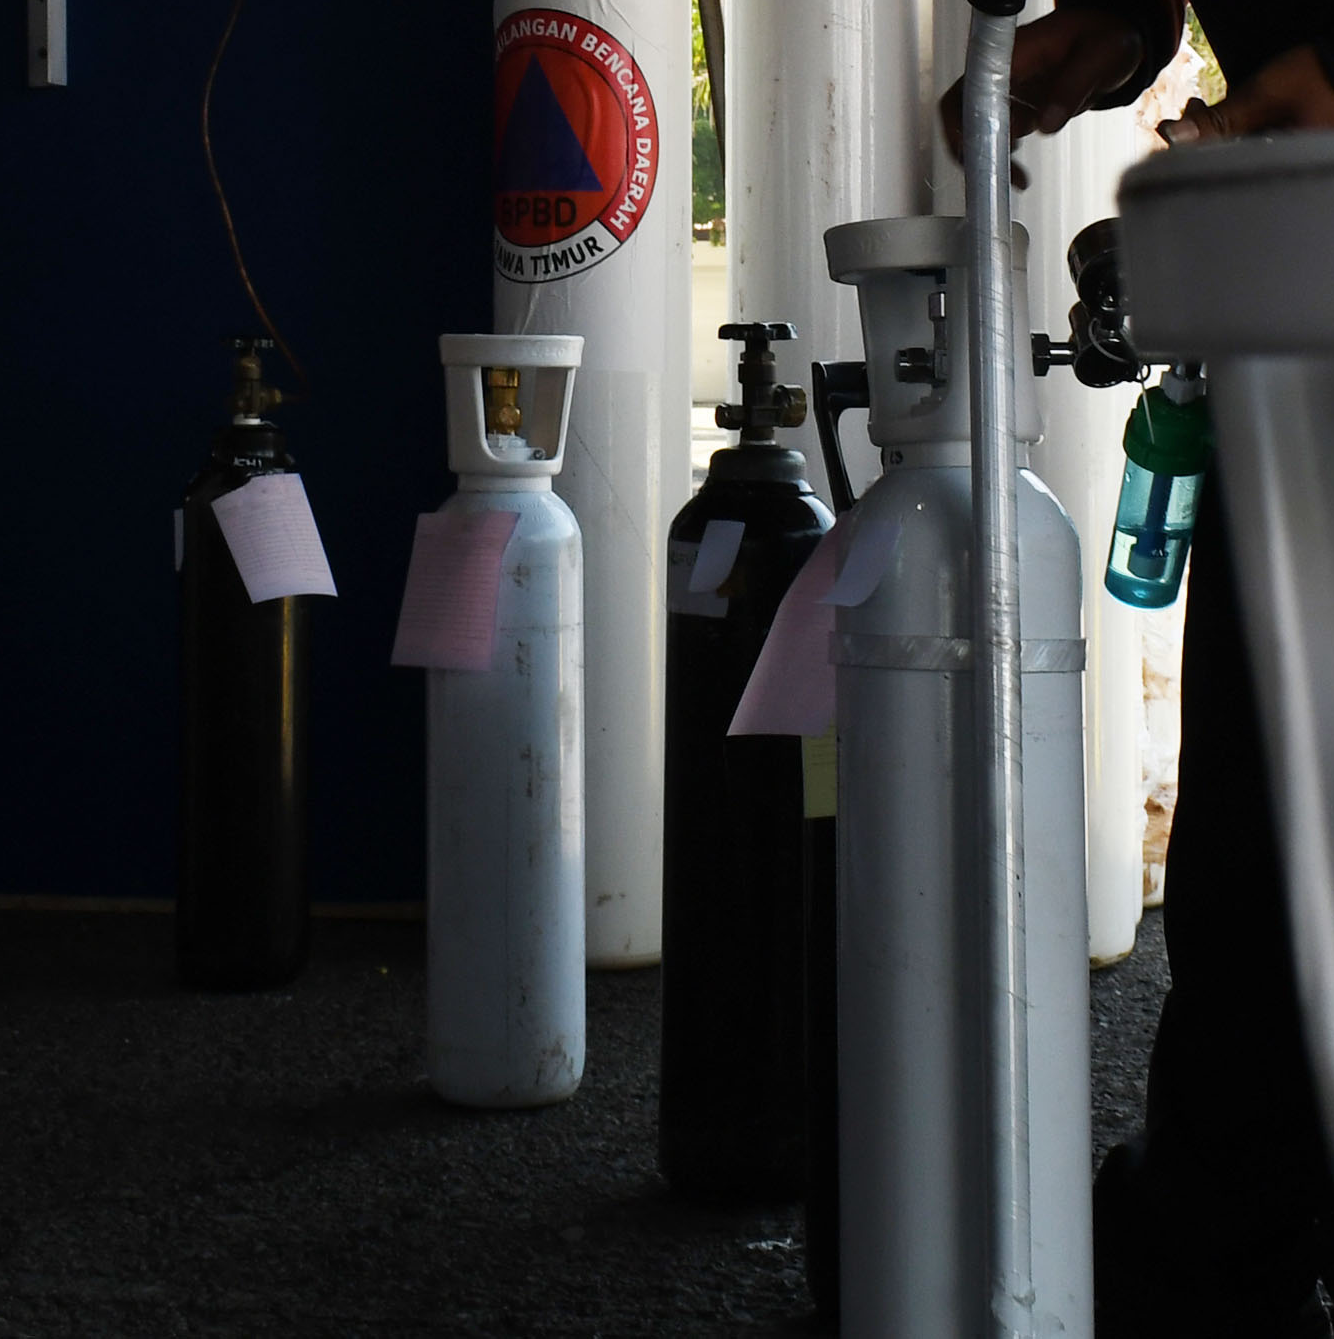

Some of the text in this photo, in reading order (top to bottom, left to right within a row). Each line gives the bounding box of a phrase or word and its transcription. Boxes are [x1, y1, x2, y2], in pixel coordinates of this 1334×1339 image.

[580, 32, 650, 131] BENCANA
[501, 196, 577, 229] BPBD
[609, 137, 652, 232] DAERAH
[531, 235, 605, 276] TIMUR
